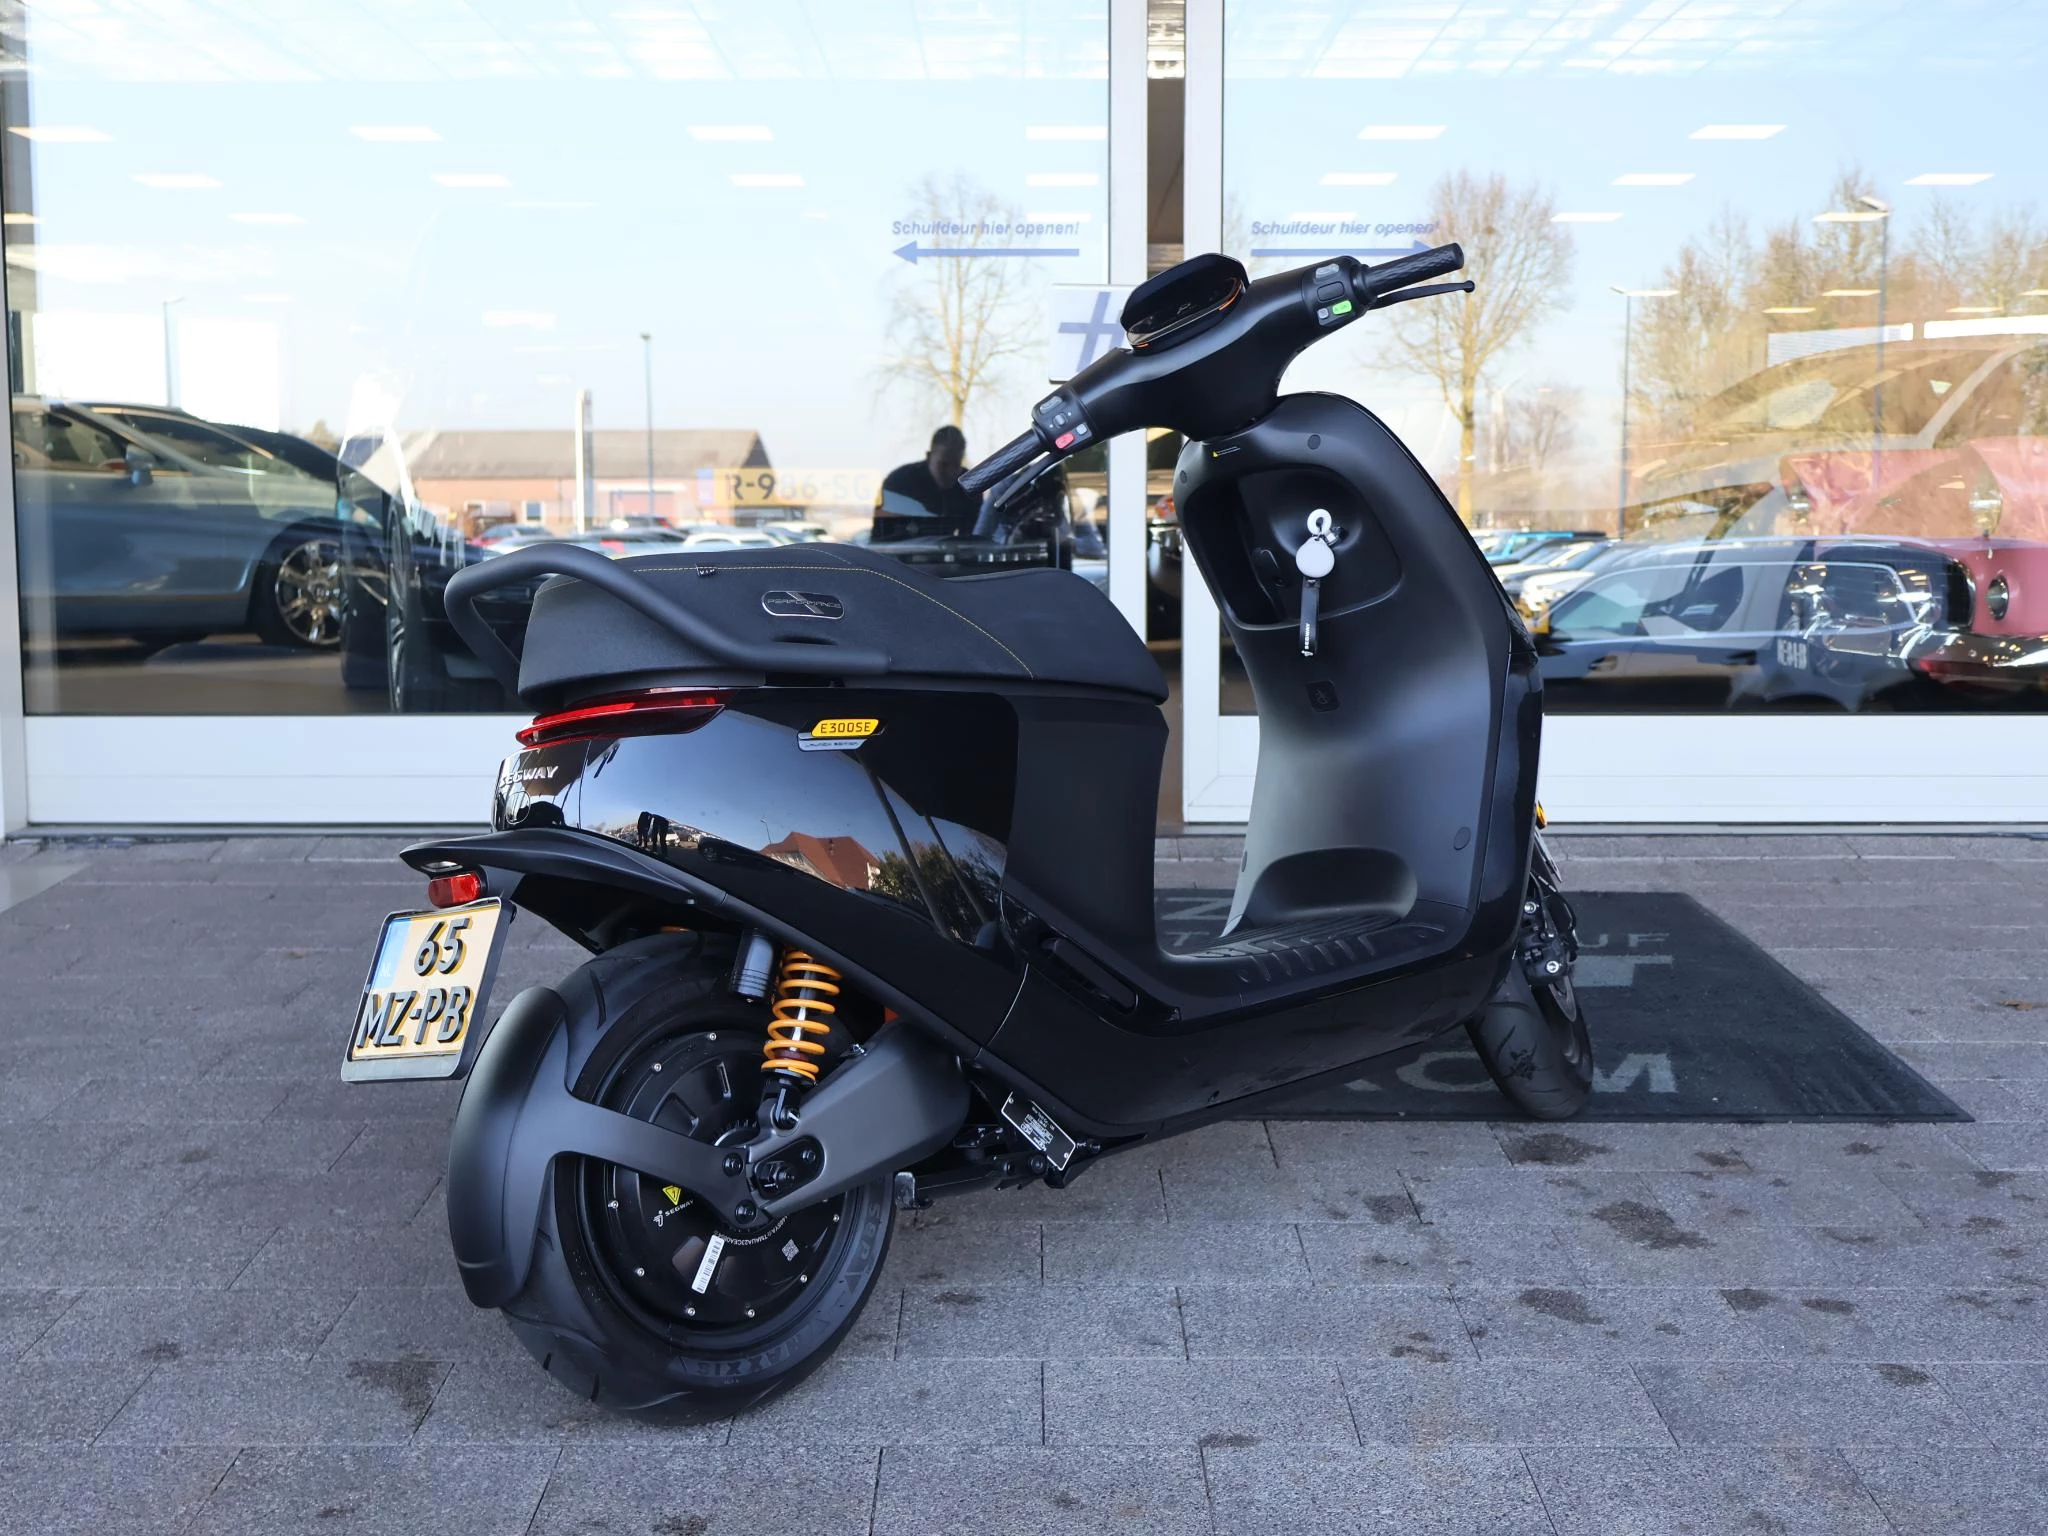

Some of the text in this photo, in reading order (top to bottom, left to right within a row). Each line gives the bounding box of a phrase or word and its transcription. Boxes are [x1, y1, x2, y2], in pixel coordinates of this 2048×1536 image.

[891, 221, 1080, 238] Schuifdeur hier openen!
[1251, 221, 1336, 235] Schuifdeur
[1340, 221, 1371, 235] hier
[820, 721, 872, 734] E300SE
[499, 765, 559, 788] SEGWAY
[414, 917, 472, 976] 65
[357, 985, 471, 1048] MZ-PB
[664, 1199, 695, 1217] SEGWAY
